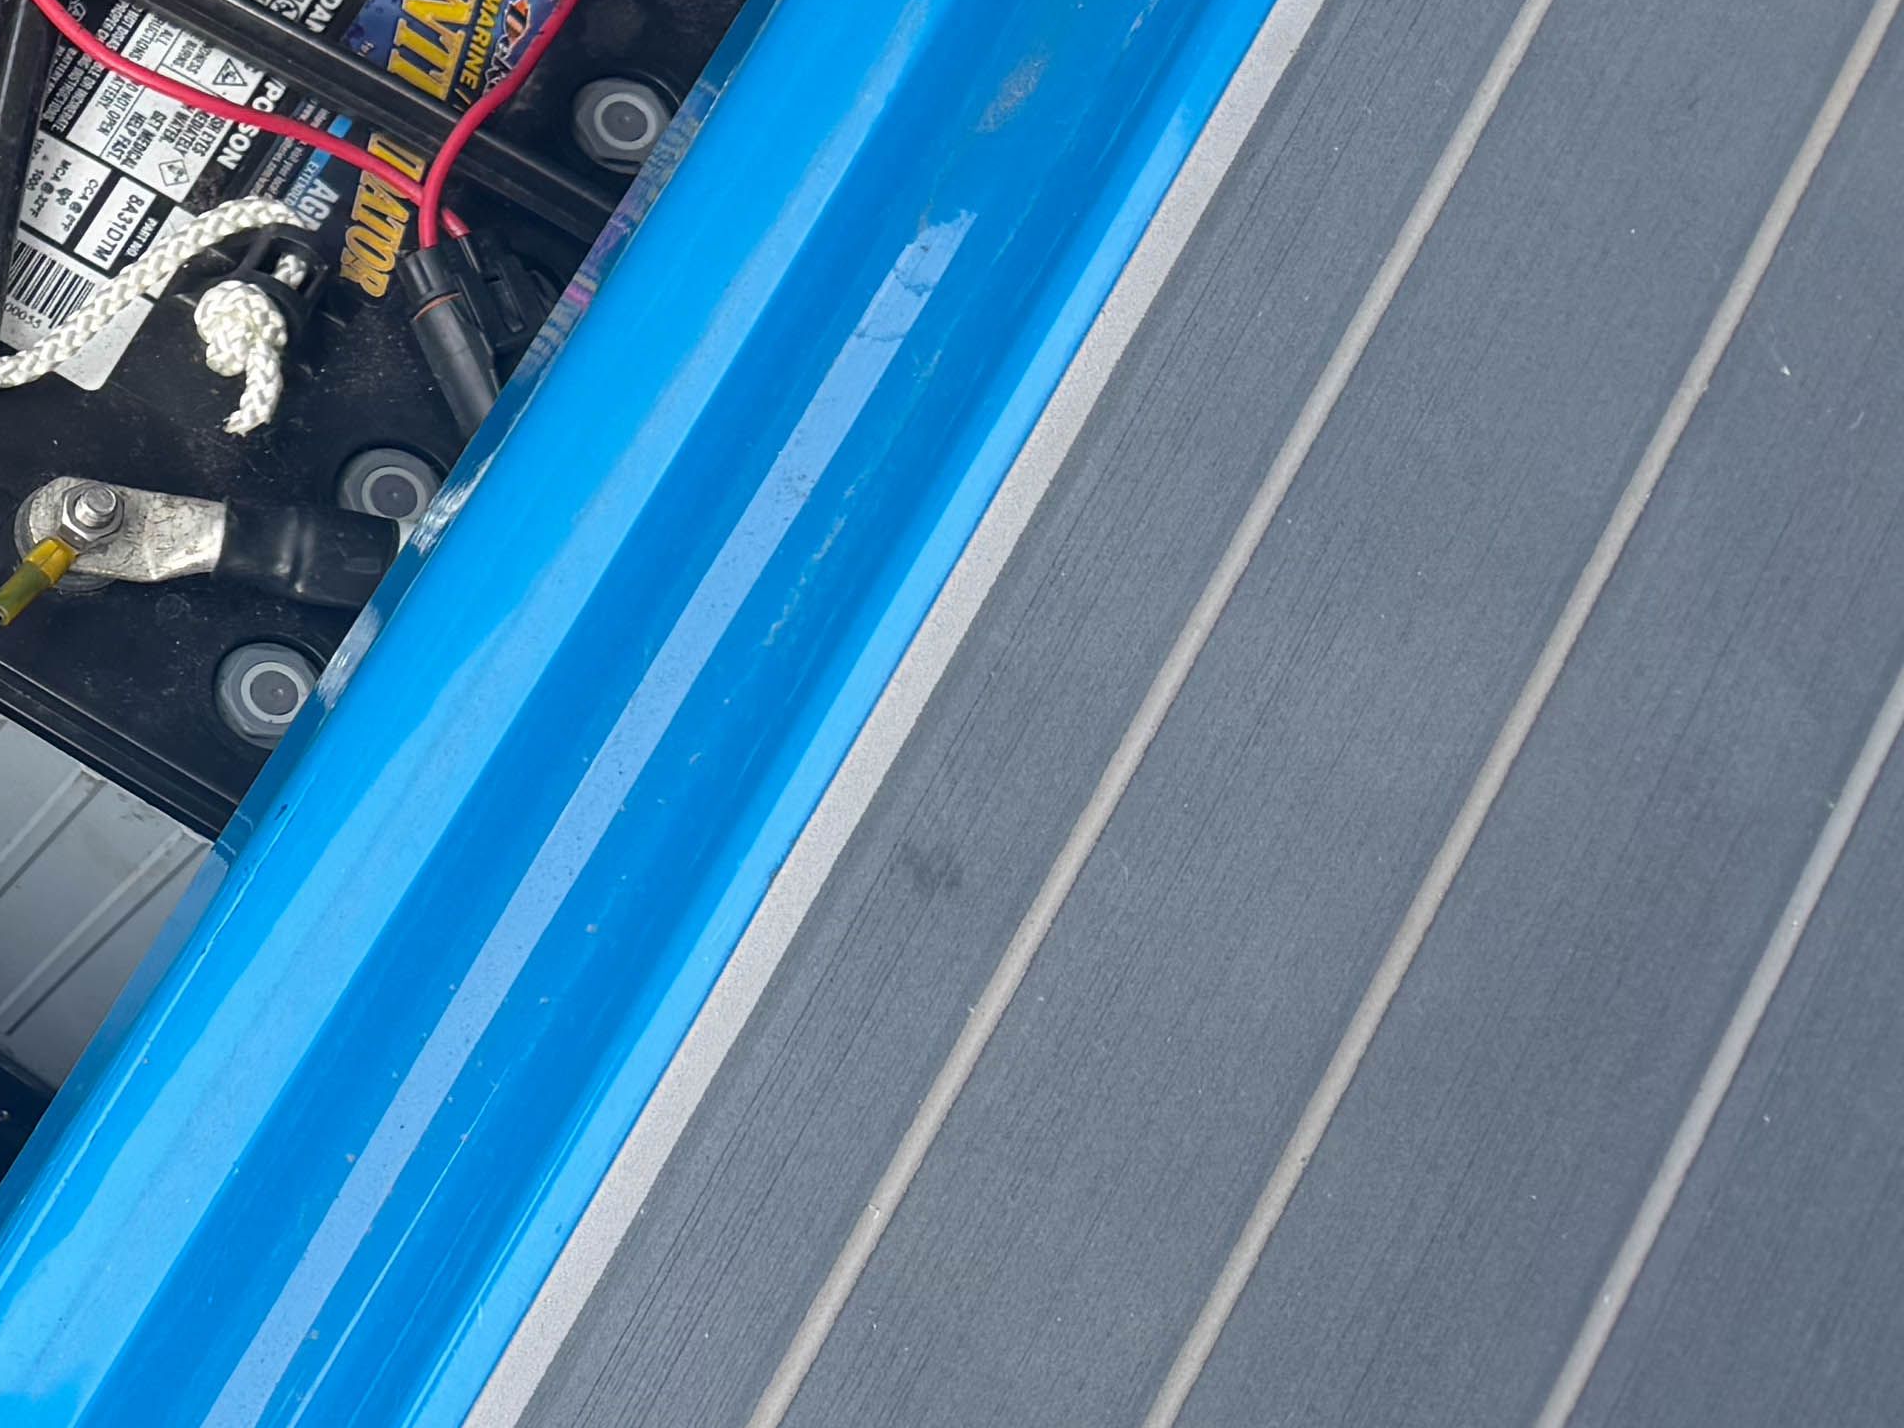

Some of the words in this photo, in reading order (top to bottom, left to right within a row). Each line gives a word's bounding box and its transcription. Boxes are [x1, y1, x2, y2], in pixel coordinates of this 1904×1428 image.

[155, 27, 175, 47] ALL
[112, 89, 134, 112] NOT
[95, 109, 121, 137] OPEN
[121, 110, 147, 138] HELP
[145, 109, 168, 132] GET
[157, 110, 189, 147] WATER.
[119, 128, 156, 171] MEDICAL
[190, 129, 216, 158] EYES
[47, 156, 72, 185] MCA
[282, 158, 320, 209] EXTENDED
[76, 175, 100, 203] CCA
[90, 192, 146, 263] 8A31DTM
[133, 215, 158, 243] PART
[123, 238, 143, 260] NO.
